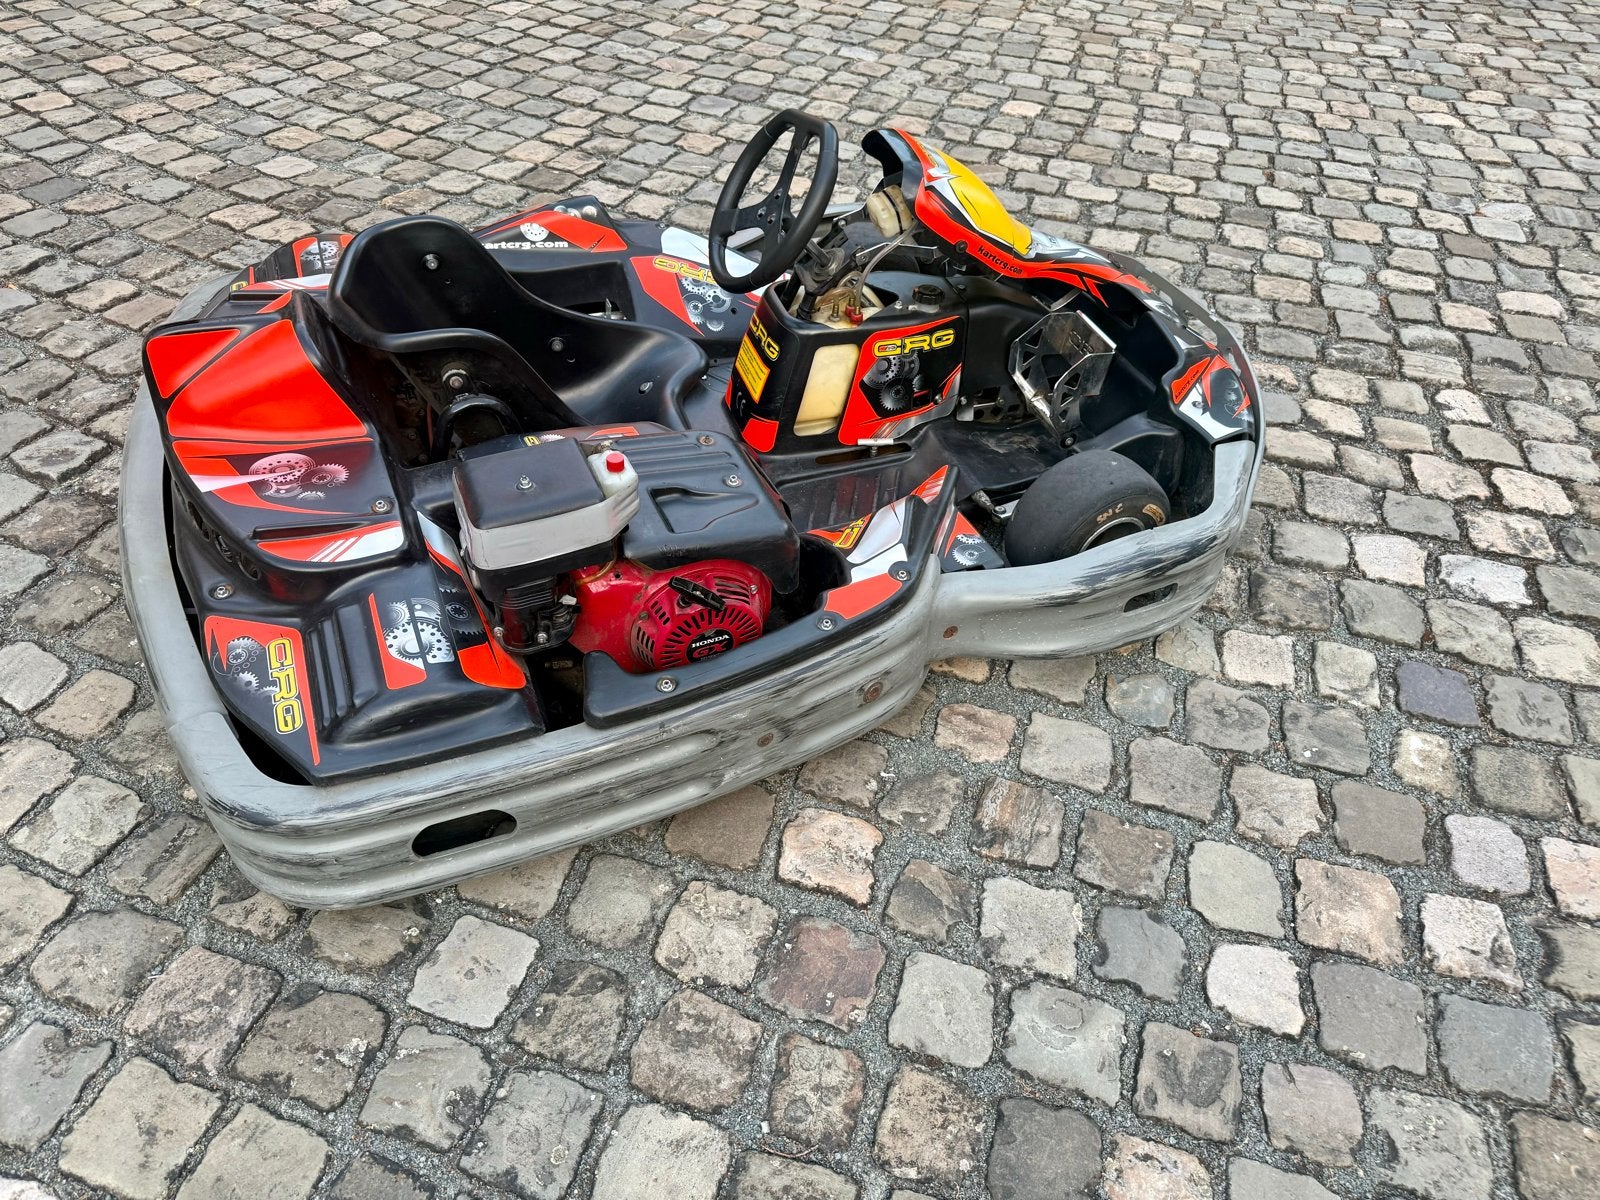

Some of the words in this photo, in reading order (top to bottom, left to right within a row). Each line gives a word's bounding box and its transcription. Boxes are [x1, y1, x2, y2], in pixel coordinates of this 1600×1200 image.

[482, 240, 569, 250] artcrg.com
[873, 329, 955, 357] CRG
[691, 634, 731, 649] HONDA
[692, 641, 729, 659] GX
[265, 637, 304, 735] CRG
